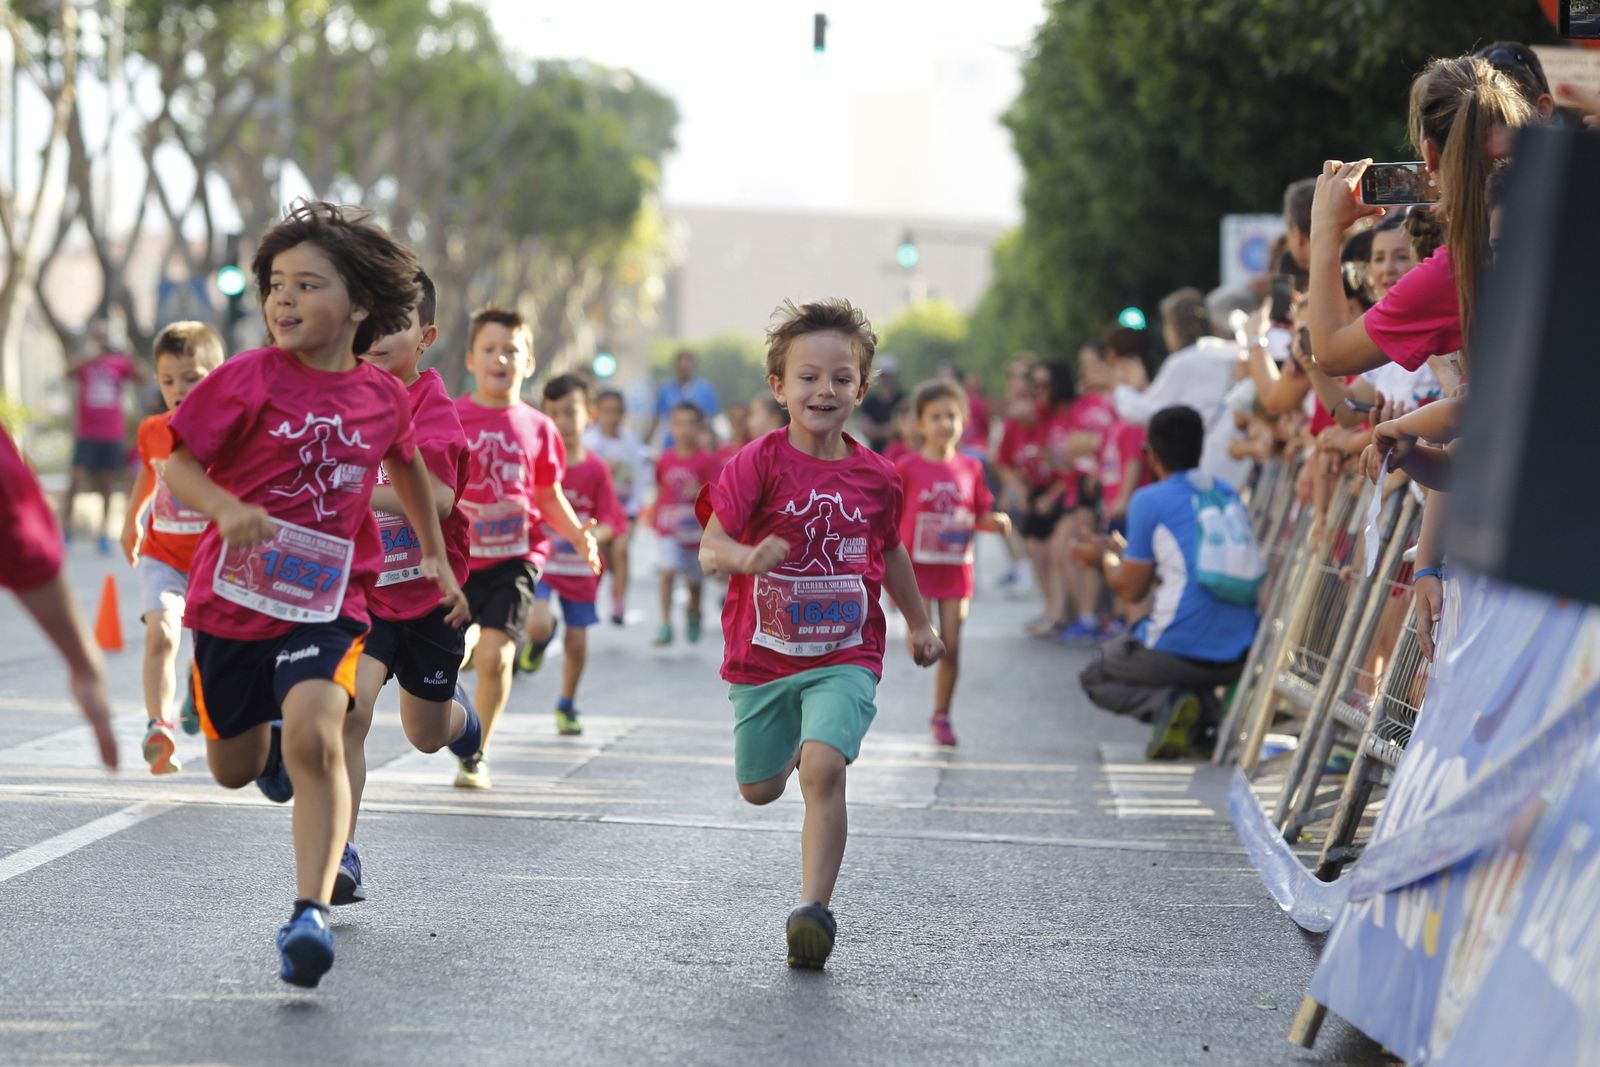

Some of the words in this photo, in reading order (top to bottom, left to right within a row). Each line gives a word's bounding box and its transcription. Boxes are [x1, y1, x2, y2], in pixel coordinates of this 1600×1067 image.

[384, 552, 408, 563] JAVIER
[835, 537, 846, 562] 4
[263, 550, 342, 593] 1527
[798, 581, 828, 589] CARRERA
[828, 580, 860, 588] SOLIDARIA
[787, 600, 861, 625] 1649
[798, 626, 814, 635] EDU
[816, 626, 831, 634] VER
[832, 625, 846, 633] LED
